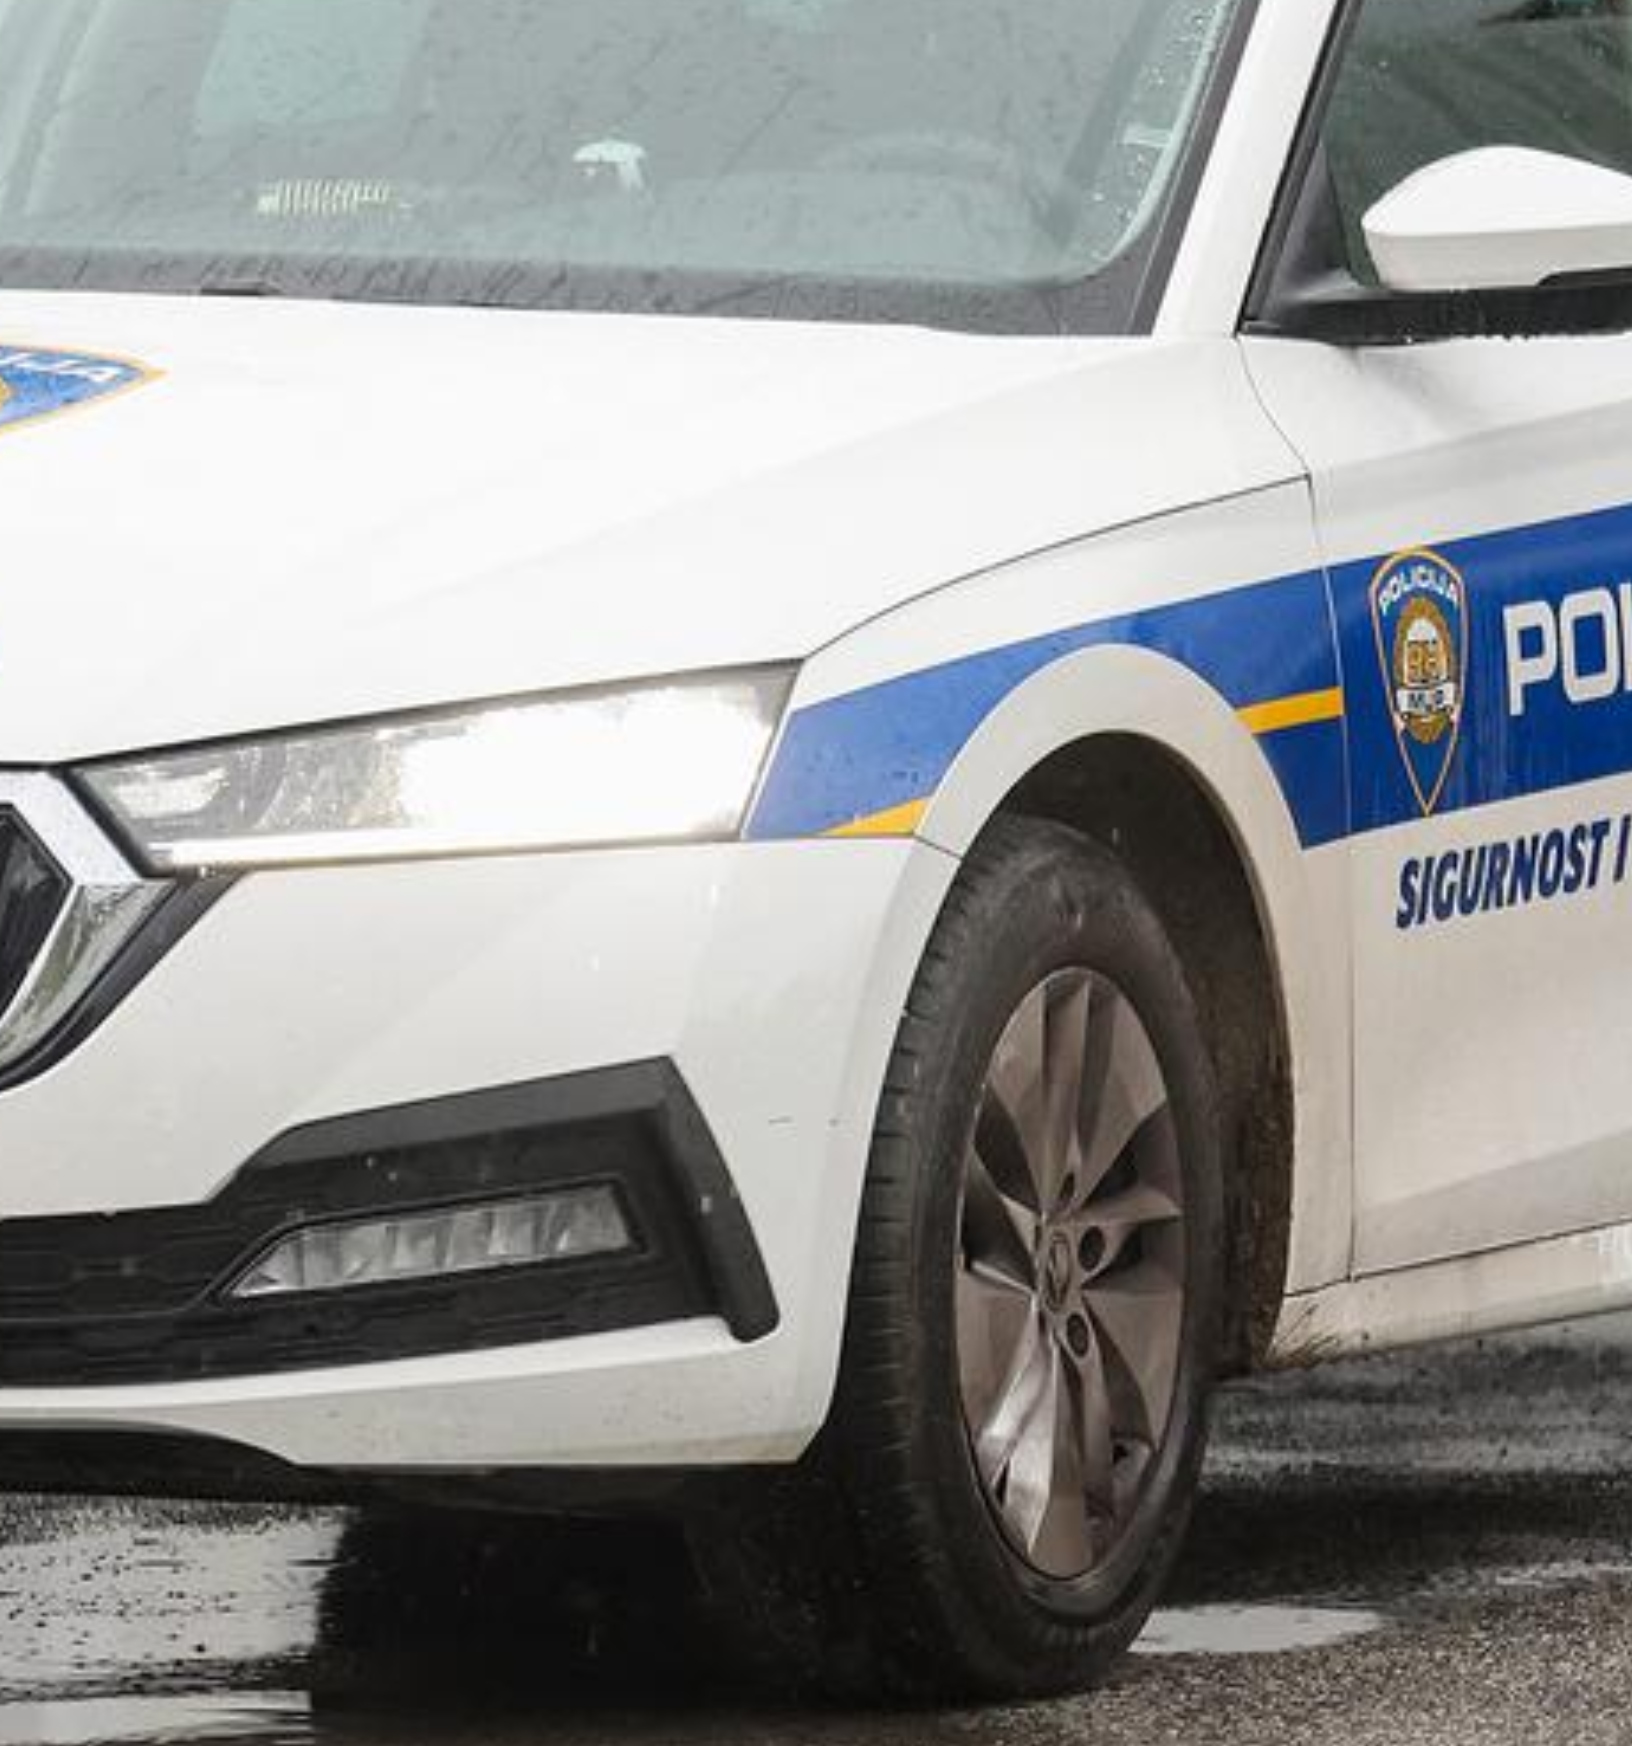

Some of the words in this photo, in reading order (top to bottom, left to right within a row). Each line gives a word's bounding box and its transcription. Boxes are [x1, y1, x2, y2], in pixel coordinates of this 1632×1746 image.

[1379, 565, 1458, 616] POLICIJA
[1502, 582, 1632, 716] PO
[1396, 817, 1611, 930] SIGURNOST
